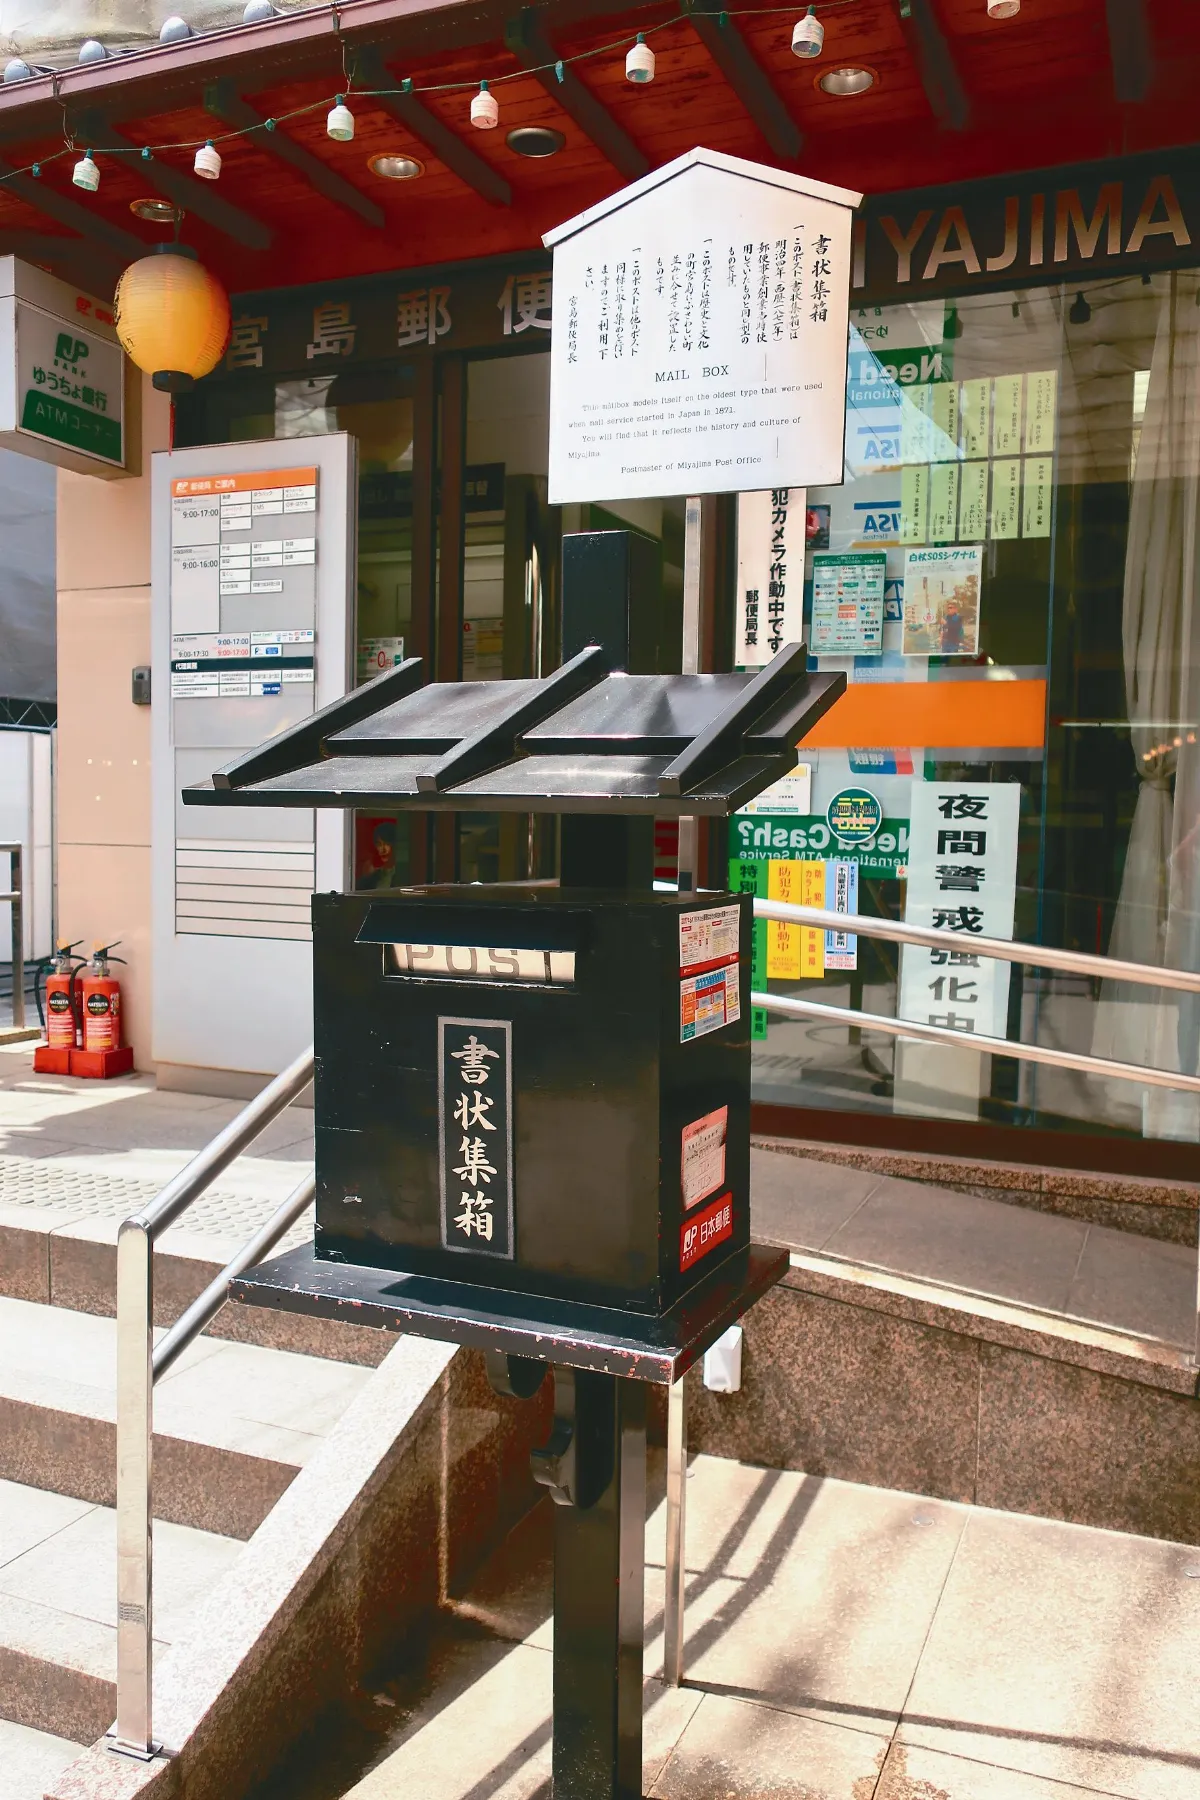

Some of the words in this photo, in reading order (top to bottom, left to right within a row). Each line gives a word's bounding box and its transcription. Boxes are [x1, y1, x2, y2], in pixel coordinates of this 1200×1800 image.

[809, 233, 832, 322] 書状集箱
[598, 264, 610, 360] ますのでご利用下
[567, 295, 579, 364] 宮島郵便局長
[53, 359, 87, 379] BANK
[655, 370, 690, 382] MAIL
[702, 365, 729, 377] BOX
[32, 366, 108, 412] ゆうちょ銀行
[602, 402, 629, 410] mailbox
[661, 396, 681, 404] itself
[713, 391, 736, 399] oldest
[740, 389, 757, 397] type
[761, 387, 777, 395] that
[804, 382, 823, 390] used
[36, 402, 113, 438] ATMコーナー
[590, 418, 604, 426] mail
[606, 416, 634, 425] service
[636, 413, 664, 422] started
[678, 410, 700, 418] Japan
[715, 406, 735, 415] 1871.
[599, 433, 612, 441] will
[633, 430, 648, 438] that
[662, 426, 692, 435] reflects
[711, 422, 739, 431] history
[742, 420, 756, 428] and
[760, 418, 789, 427] culture
[792, 416, 801, 424] of
[621, 463, 663, 474] Postmaster
[677, 461, 711, 471] Miyajima
[715, 458, 732, 466] Post
[736, 456, 762, 465] Office
[182, 509, 219, 519] 9:00-17:00
[182, 560, 218, 570] 9:00-16:00
[909, 551, 977, 562] 白杖SOSシグナル
[745, 590, 759, 645] 郵便局長
[217, 638, 249, 646] 9:00-17:00
[217, 648, 249, 656] 9:00-17:00
[450, 1035, 500, 1241] 書状集箱
[700, 1204, 731, 1245] 日本郵便
